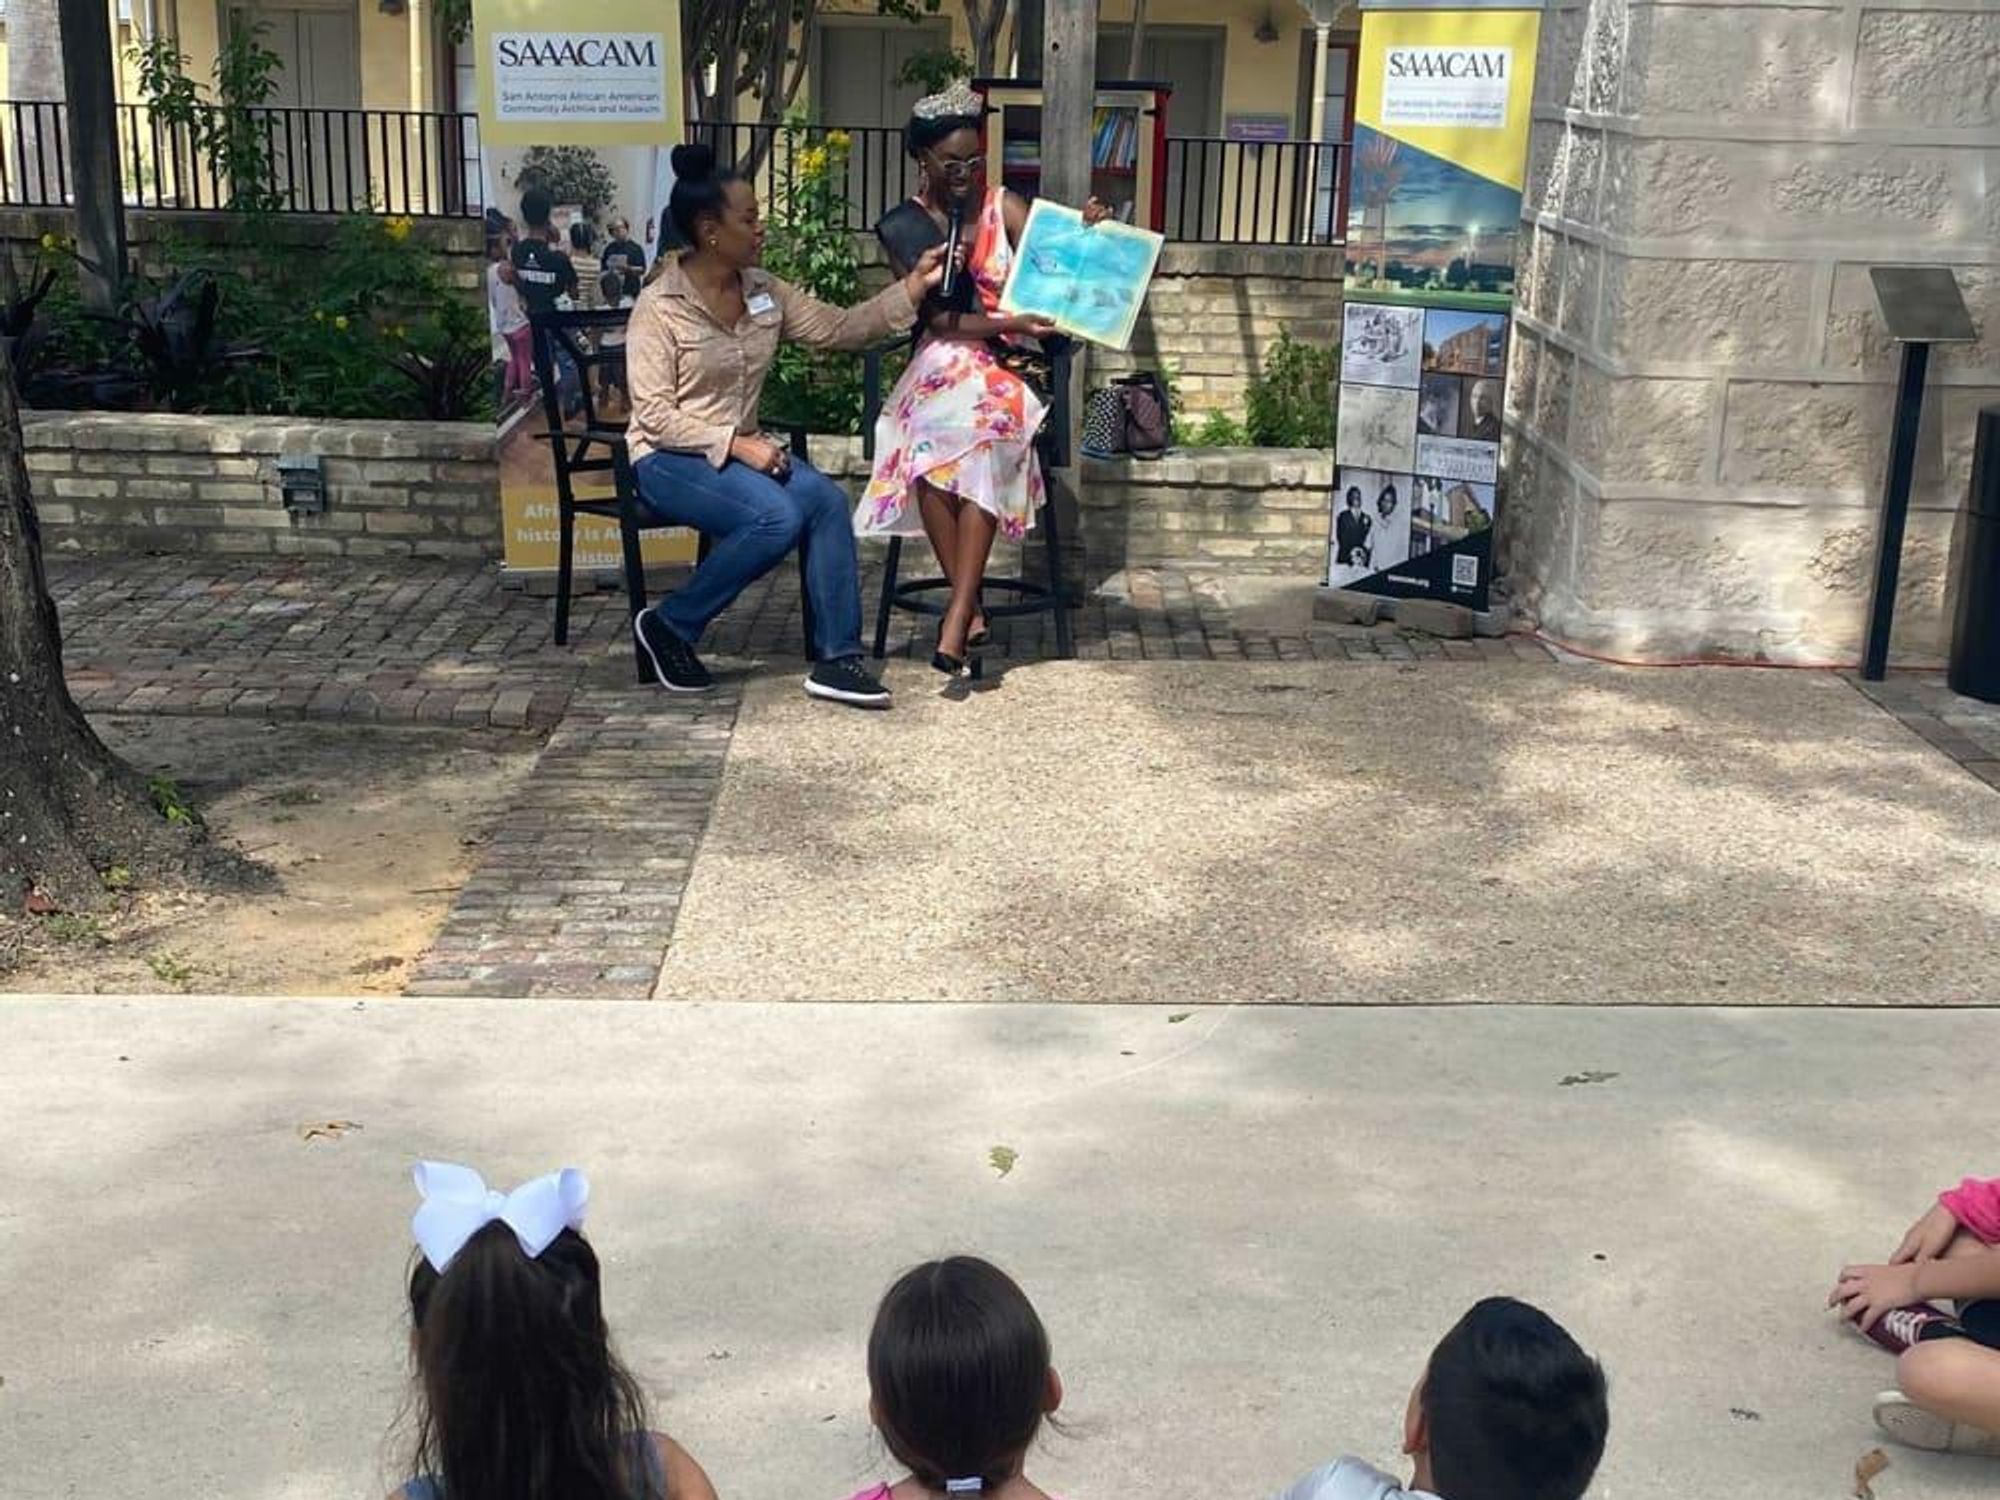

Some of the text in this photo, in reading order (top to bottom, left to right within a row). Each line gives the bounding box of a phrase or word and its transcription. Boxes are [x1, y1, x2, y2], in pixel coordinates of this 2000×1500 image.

[498, 39, 657, 67] SAAACAM
[1389, 52, 1504, 78] SAAACAM
[502, 91, 659, 102] San Antonio African American
[502, 104, 660, 116] Community Archive and Museum
[516, 528, 580, 545] histoy
